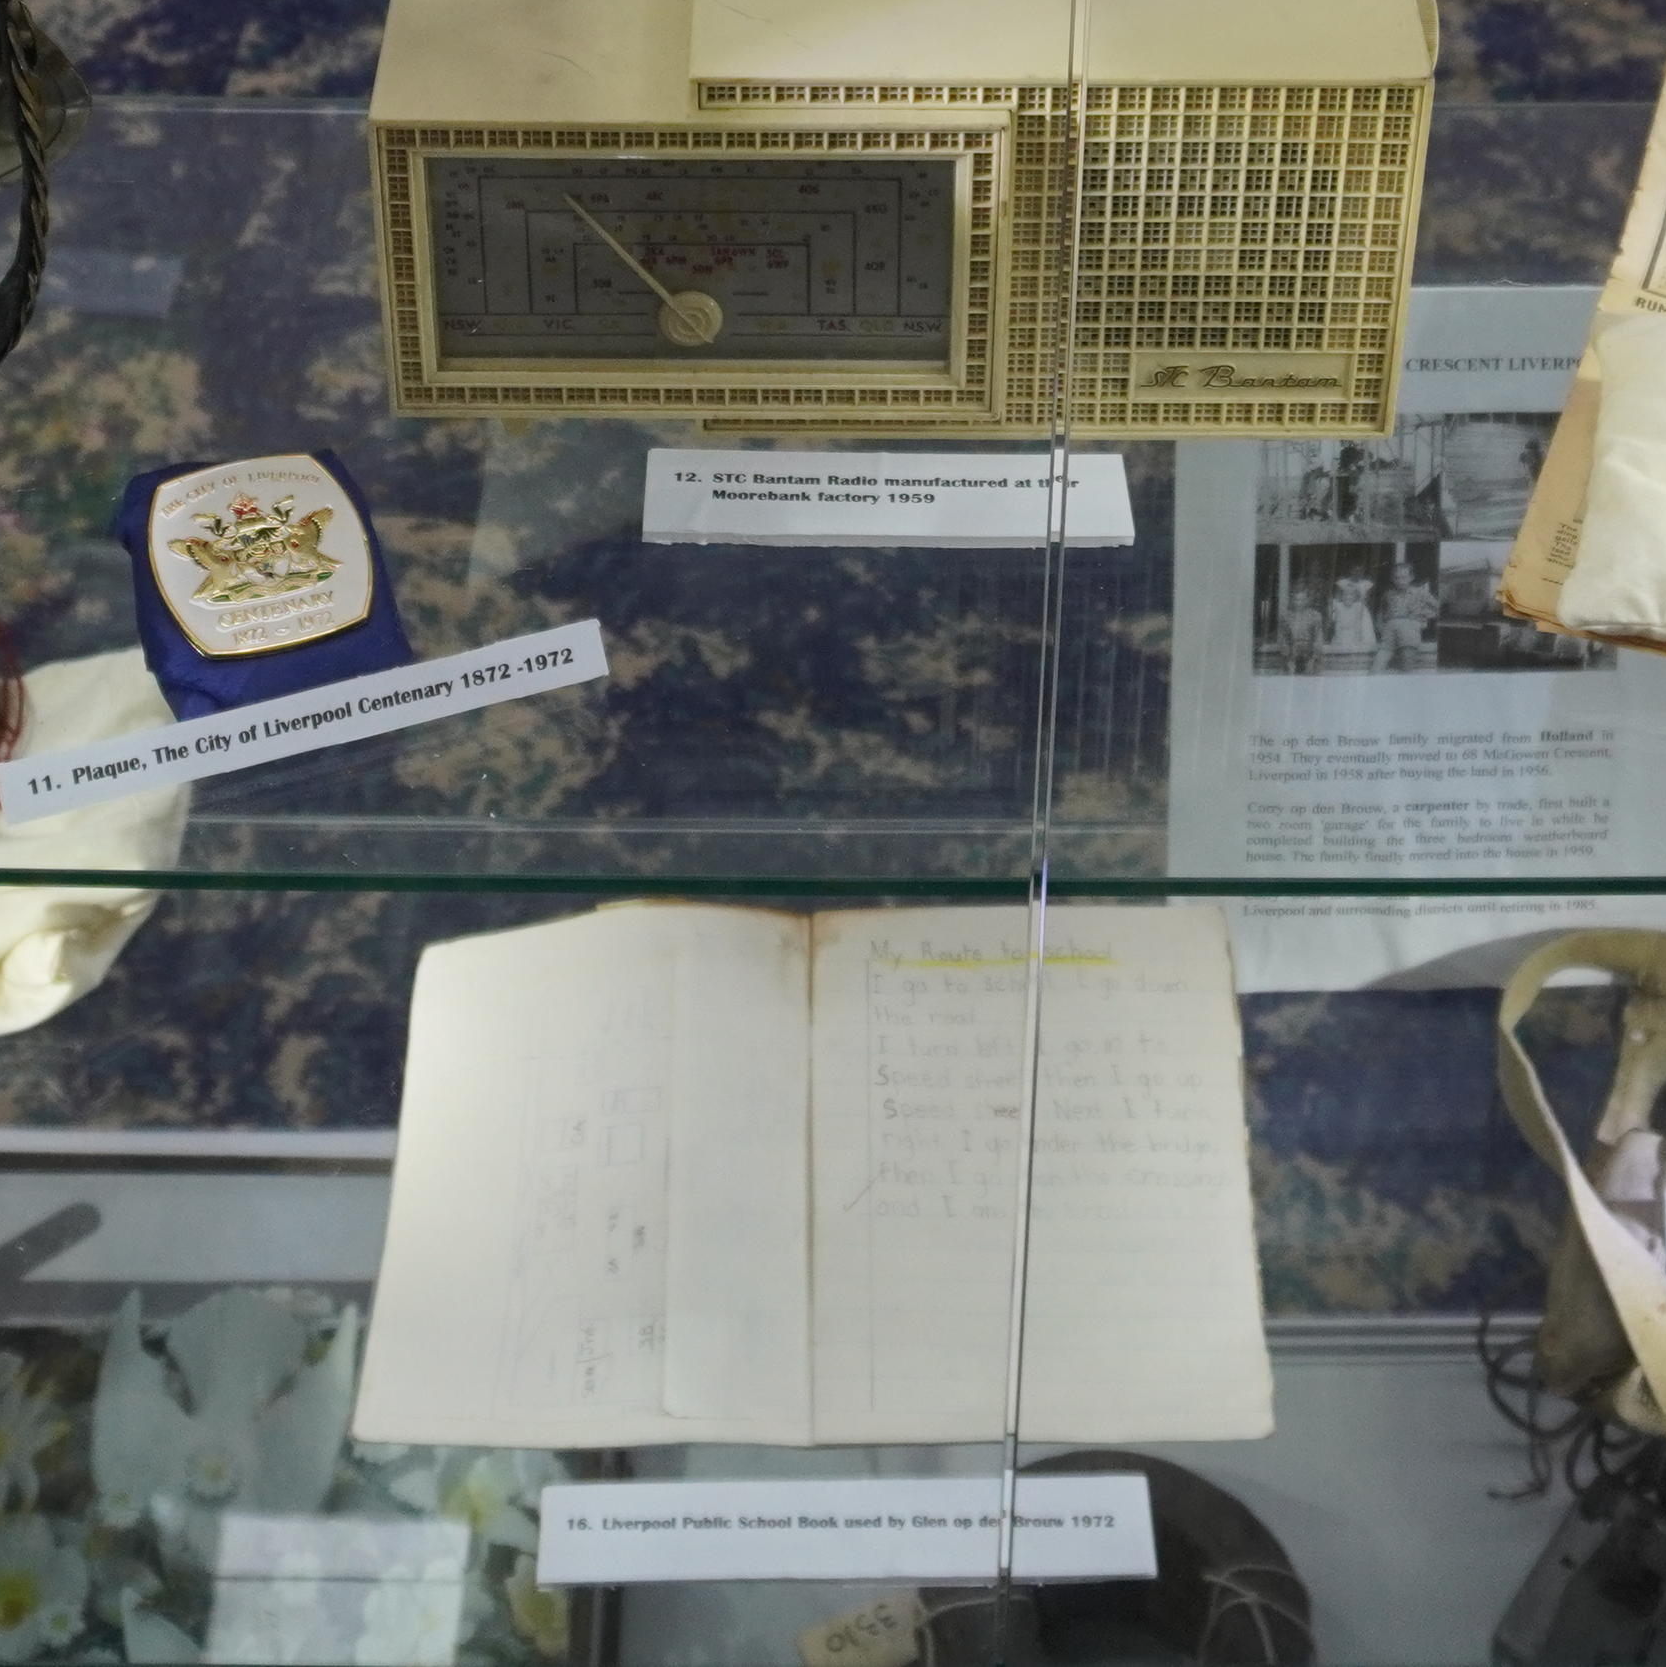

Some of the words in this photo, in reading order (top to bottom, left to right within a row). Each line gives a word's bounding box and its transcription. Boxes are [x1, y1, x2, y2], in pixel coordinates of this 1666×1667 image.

[1406, 358, 1504, 372] CRESCENT
[1199, 364, 1341, 389] Bantam
[674, 472, 702, 483] 12.
[712, 472, 747, 484] STC
[752, 473, 821, 485] Bantam
[827, 475, 878, 486] Radio
[884, 477, 1008, 488] manufactured
[1014, 478, 1032, 488] at
[712, 489, 811, 502] Moorebank
[817, 491, 880, 505] factory
[887, 492, 935, 504] 1959
[217, 590, 335, 629] CENTENARY
[28, 774, 62, 795] 11.
[71, 757, 147, 785] Plaque,
[151, 745, 190, 765] The
[194, 734, 232, 755] City
[238, 724, 257, 744] of
[263, 701, 352, 738] Liverpool
[357, 680, 453, 714] Centenary
[460, 663, 512, 689] 1872
[567, 1517, 592, 1531] 16.
[601, 1517, 677, 1533] Liverpool
[681, 1516, 732, 1530] Public
[737, 1516, 792, 1529] School
[797, 1515, 839, 1529] Book
[843, 1515, 883, 1529] used
[887, 1515, 906, 1529] by
[911, 1514, 948, 1528] Glen
[953, 1517, 973, 1530] op
[1071, 1514, 1115, 1528] 1972
